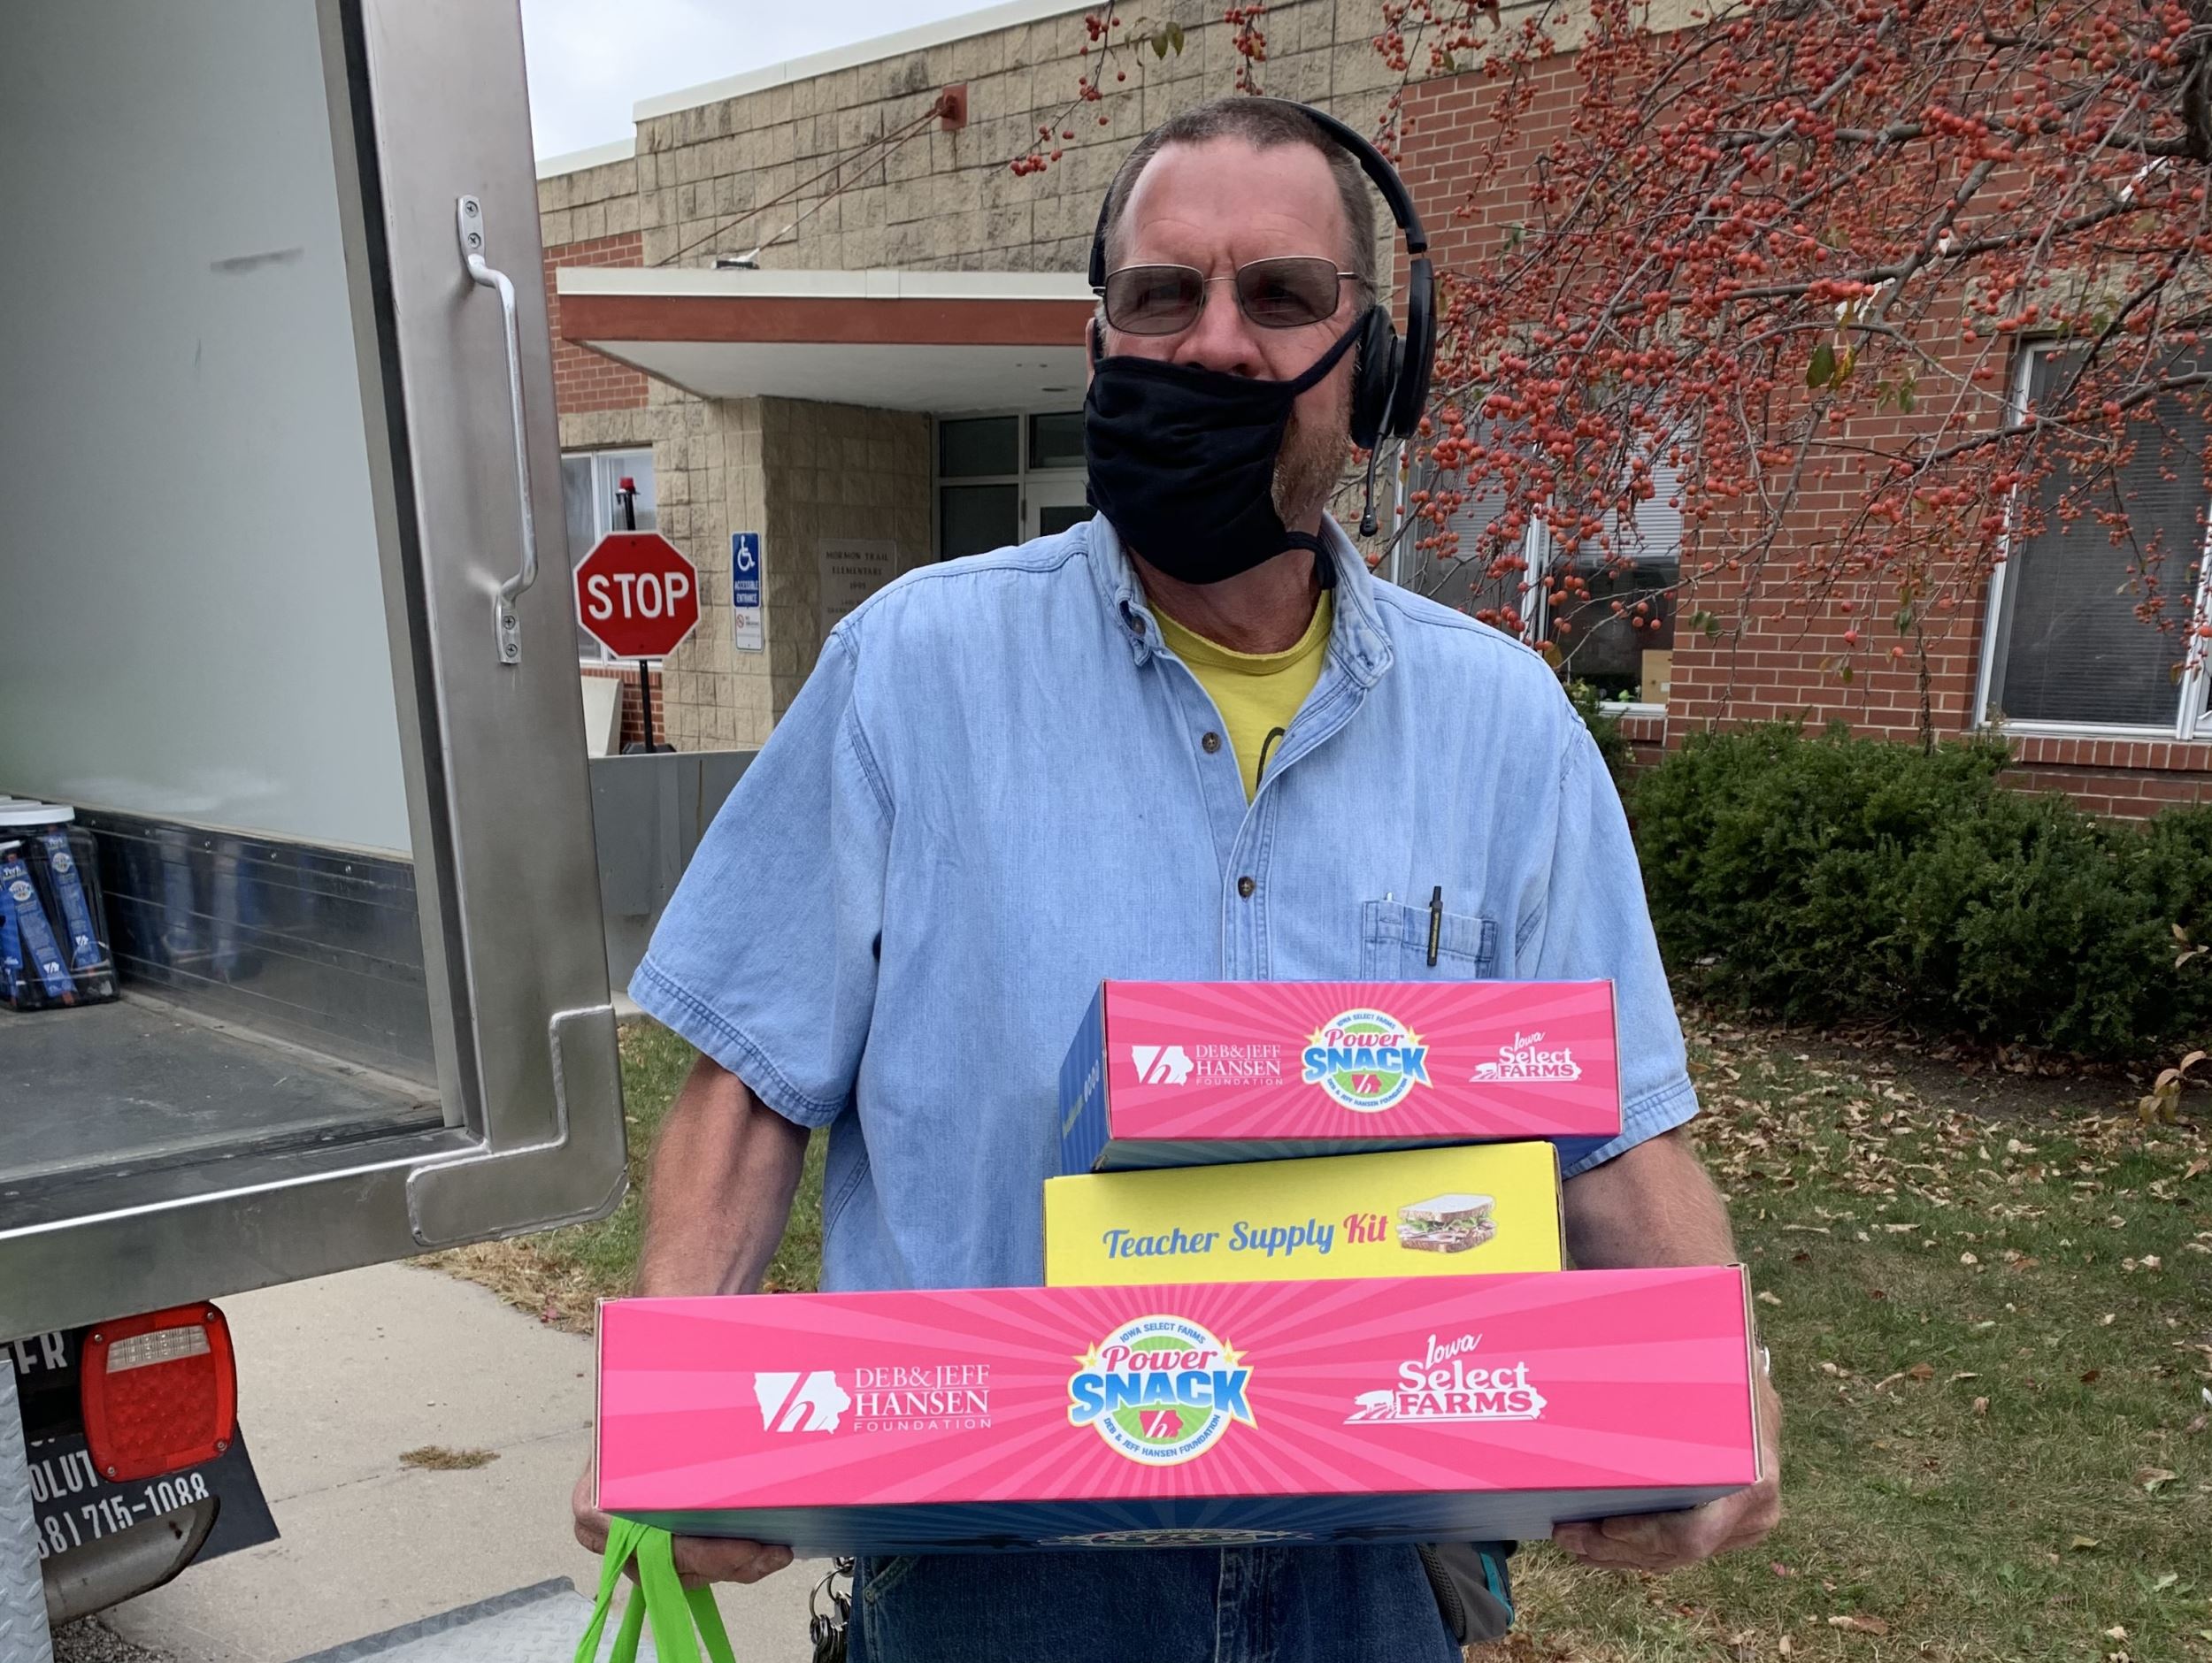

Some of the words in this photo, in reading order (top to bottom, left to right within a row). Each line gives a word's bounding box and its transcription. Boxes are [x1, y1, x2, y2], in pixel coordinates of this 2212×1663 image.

[588, 571, 689, 619] STOP
[734, 579, 759, 591] ACCESSIBLE
[736, 593, 757, 603] ENTRANCE
[1376, 1015, 1396, 1030] FARMS
[1325, 1029, 1404, 1047] Power
[1514, 1031, 1546, 1052] Iowa
[1304, 1047, 1428, 1082] SNACK
[1499, 1046, 1571, 1063] Select
[1196, 1061, 1281, 1076] HANSEN
[1501, 1064, 1574, 1077] FARMS
[1102, 1228, 1220, 1259] Teacher
[1230, 1218, 1334, 1258] Supply
[1343, 1213, 1389, 1245] Kit
[1119, 1328, 1142, 1343] IOWA
[1144, 1322, 1175, 1332] SELECT
[1177, 1325, 1207, 1345] FARMS
[1102, 1345, 1217, 1372] Power
[1425, 1333, 1483, 1370] Iowa
[1398, 1360, 1529, 1391] Select
[855, 1390, 989, 1417] HANSEN
[1071, 1370, 1251, 1422] SNACK
[1399, 1391, 1532, 1414] FARMS
[854, 1419, 992, 1432] FOUNDATION
[1103, 1417, 1116, 1435] DEB
[1115, 1433, 1122, 1442] &
[1122, 1439, 1140, 1453] JEFF
[1141, 1448, 1178, 1458] HANSEN
[1179, 1414, 1221, 1455] FOUNDATION
[81, 1473, 210, 1539] 715-1088
